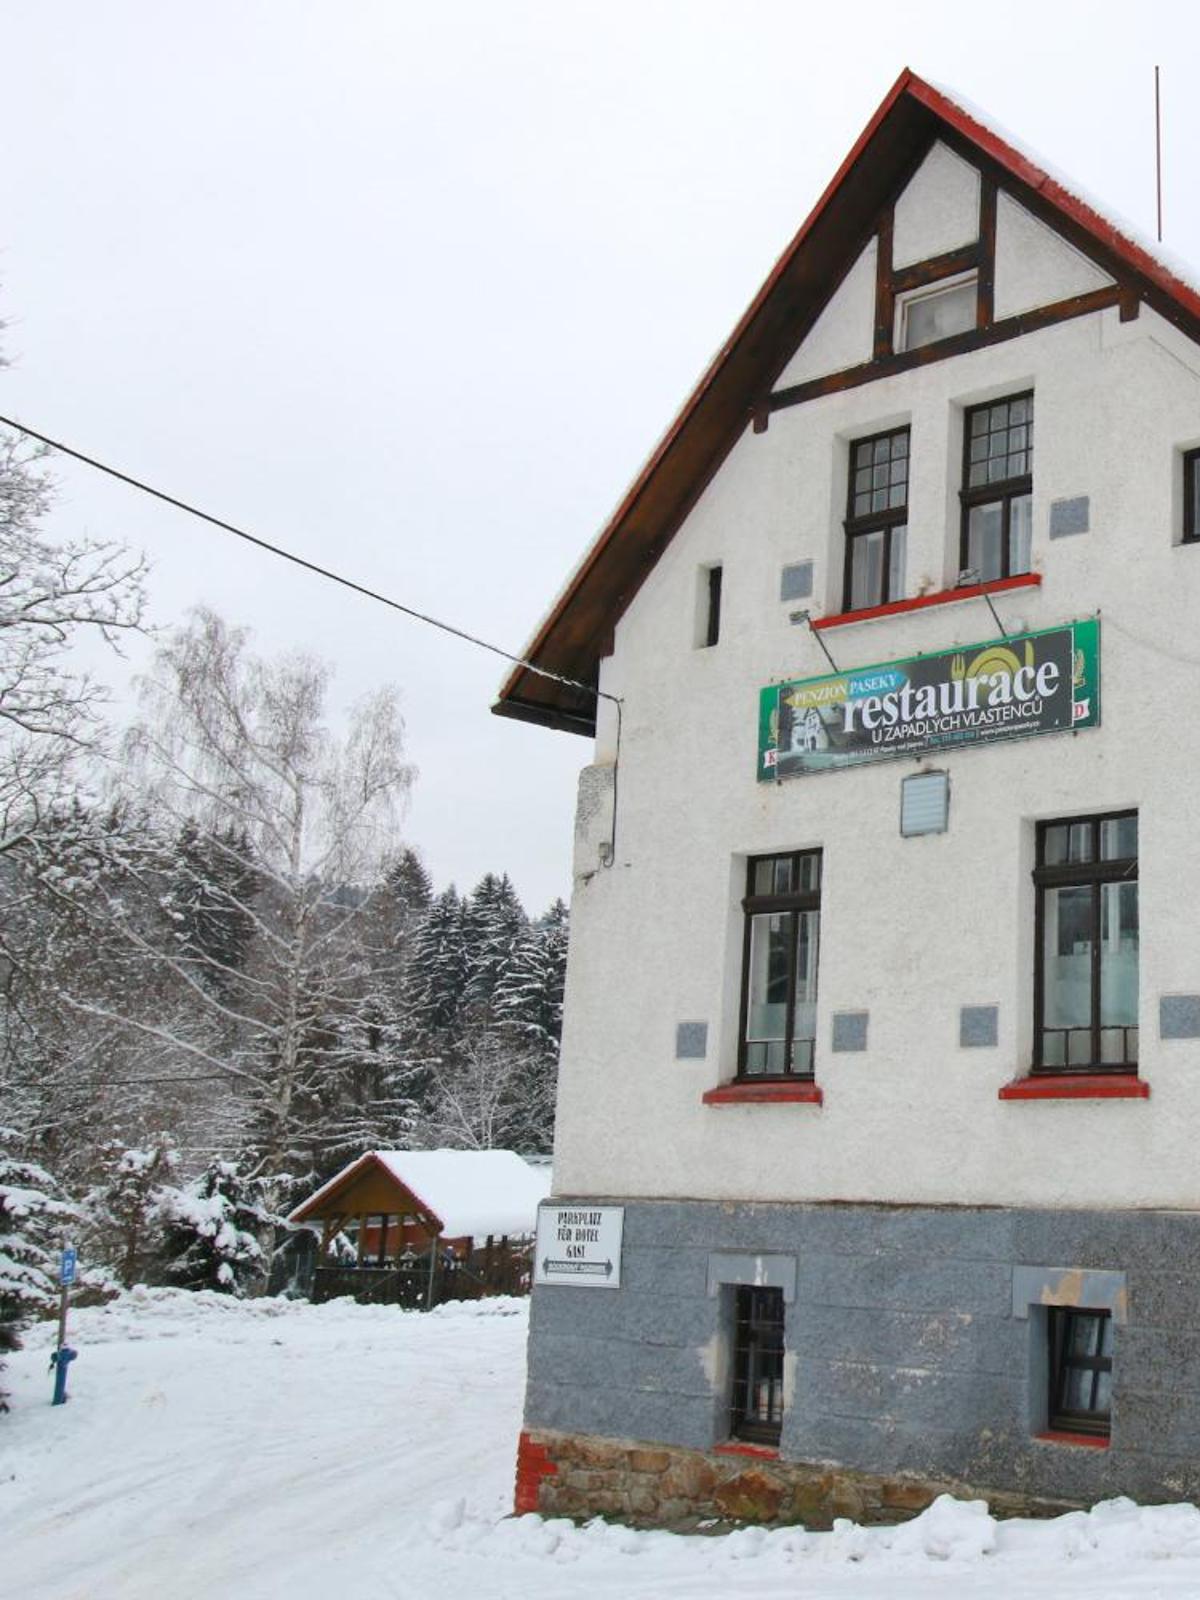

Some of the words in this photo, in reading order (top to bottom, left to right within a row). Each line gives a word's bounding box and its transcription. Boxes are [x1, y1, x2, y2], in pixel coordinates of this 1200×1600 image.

[850, 674, 898, 695] PASEKY
[843, 661, 1060, 733] restaurace
[872, 729, 882, 743] U
[885, 714, 960, 741] ZAPADLÝCH
[963, 695, 1042, 726] VLASTENCŮ
[557, 1211, 602, 1226] PARKPLATZ
[557, 1225, 572, 1241] FÜR
[575, 1228, 598, 1242] HOTEL
